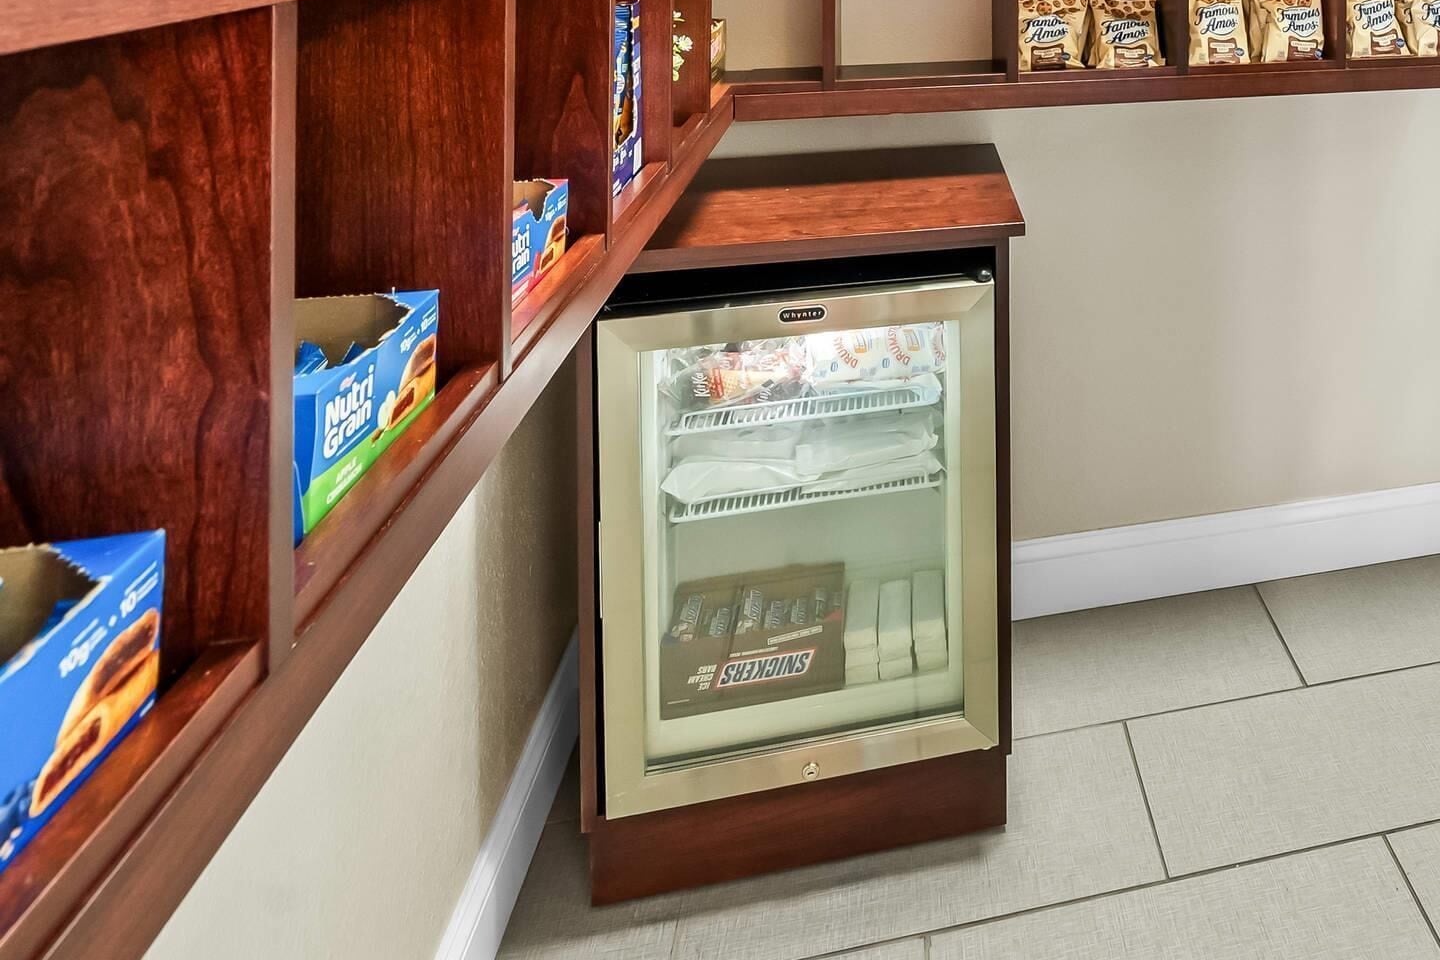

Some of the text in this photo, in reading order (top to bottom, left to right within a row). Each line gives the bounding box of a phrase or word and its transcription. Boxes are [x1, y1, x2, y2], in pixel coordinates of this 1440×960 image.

[1194, 6, 1239, 26] Famous
[1277, 7, 1321, 23] Famous
[1353, 0, 1394, 21] Famous
[1101, 20, 1150, 36] Famous
[1200, 18, 1236, 38] Amos
[1283, 21, 1316, 33] Amos
[1362, 11, 1393, 30] Amos
[1106, 30, 1146, 45] Amos
[782, 309, 823, 320] Whynter
[325, 364, 375, 437] Nutri
[323, 399, 372, 459] Grain
[719, 652, 811, 686] SNICKERS
